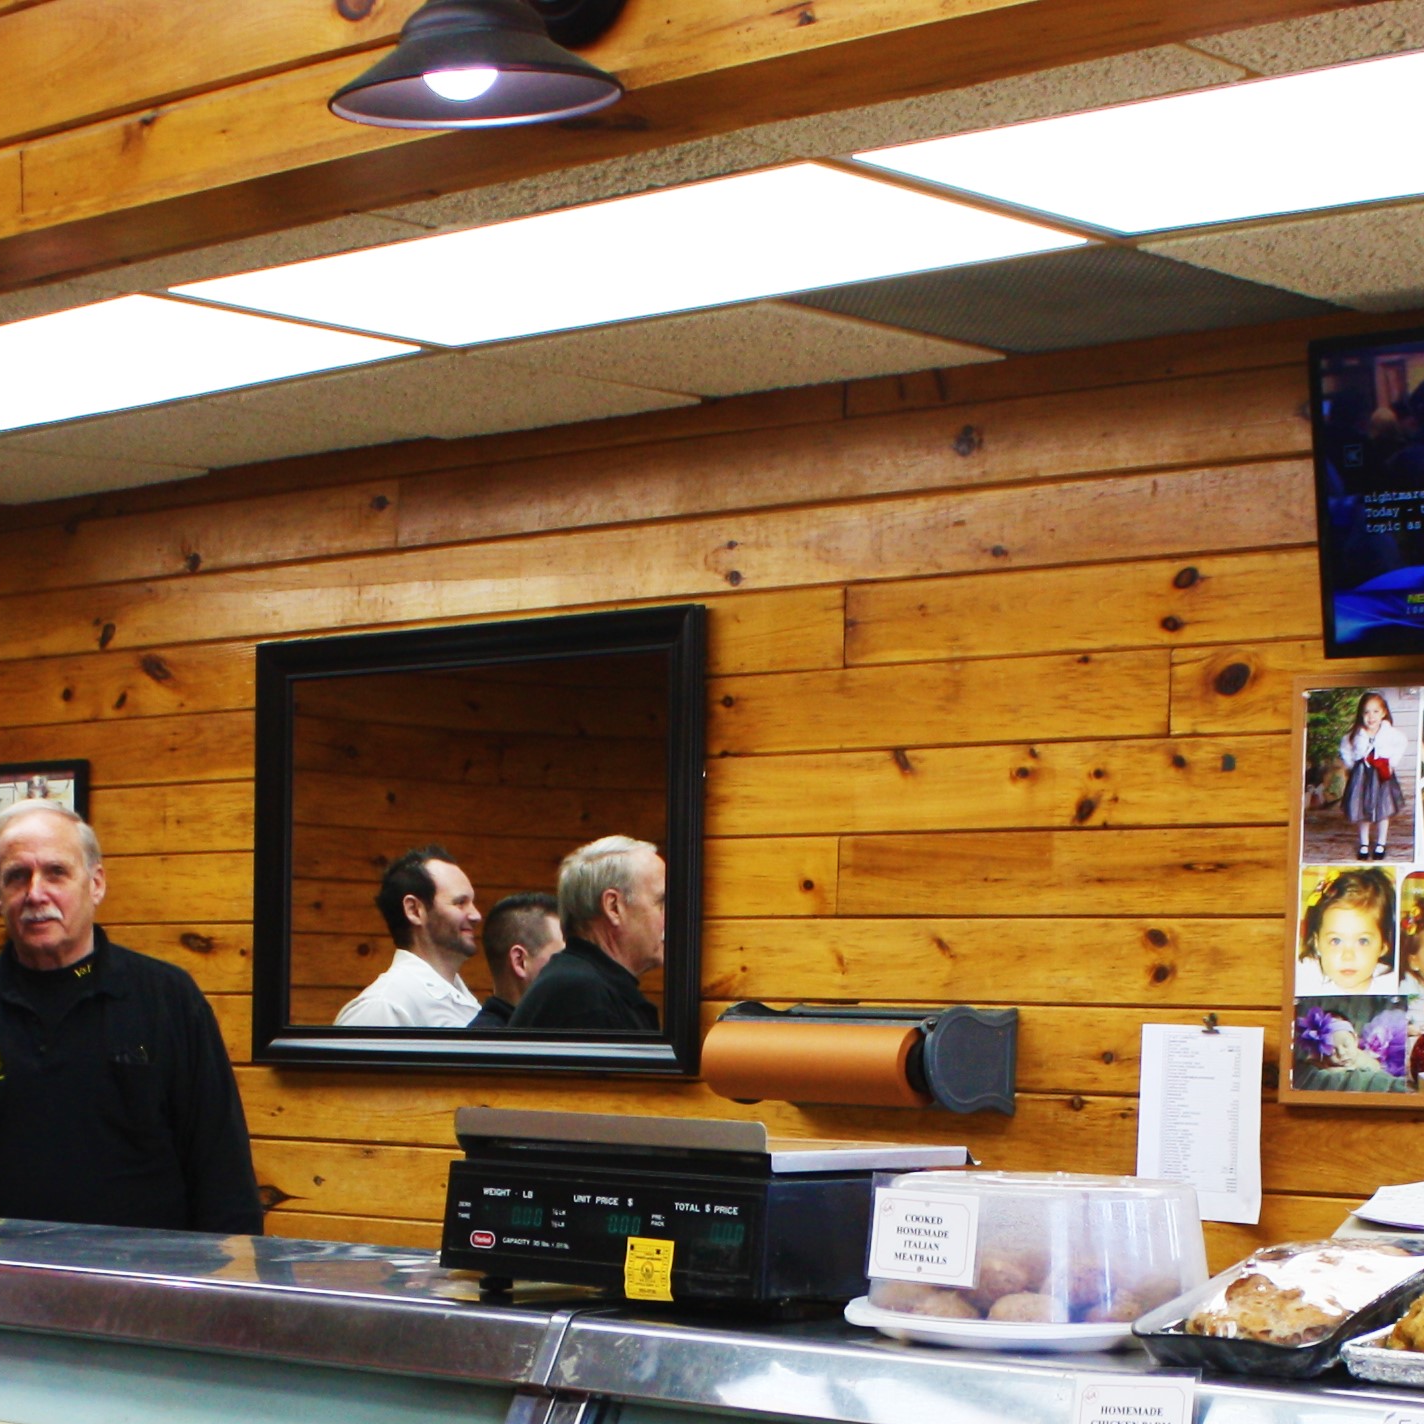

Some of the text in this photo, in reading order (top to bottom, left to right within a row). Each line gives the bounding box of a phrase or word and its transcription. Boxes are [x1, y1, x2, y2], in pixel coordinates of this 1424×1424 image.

[1365, 507, 1400, 518] Today
[1365, 520, 1401, 533] topic
[1407, 520, 1422, 530] as
[482, 1187, 534, 1199] WEIGHT LB
[573, 1194, 634, 1208] UNIT PRICE $
[674, 1202, 740, 1216] TOTAL $ PRICE
[905, 1213, 944, 1225] COOKED
[896, 1226, 950, 1239] HOMEMADE
[502, 1236, 531, 1246] CAPACITY
[903, 1239, 940, 1251] ITALIAN
[894, 1252, 948, 1265] MEATBALLS
[1100, 1405, 1164, 1418] HOMEMADE
